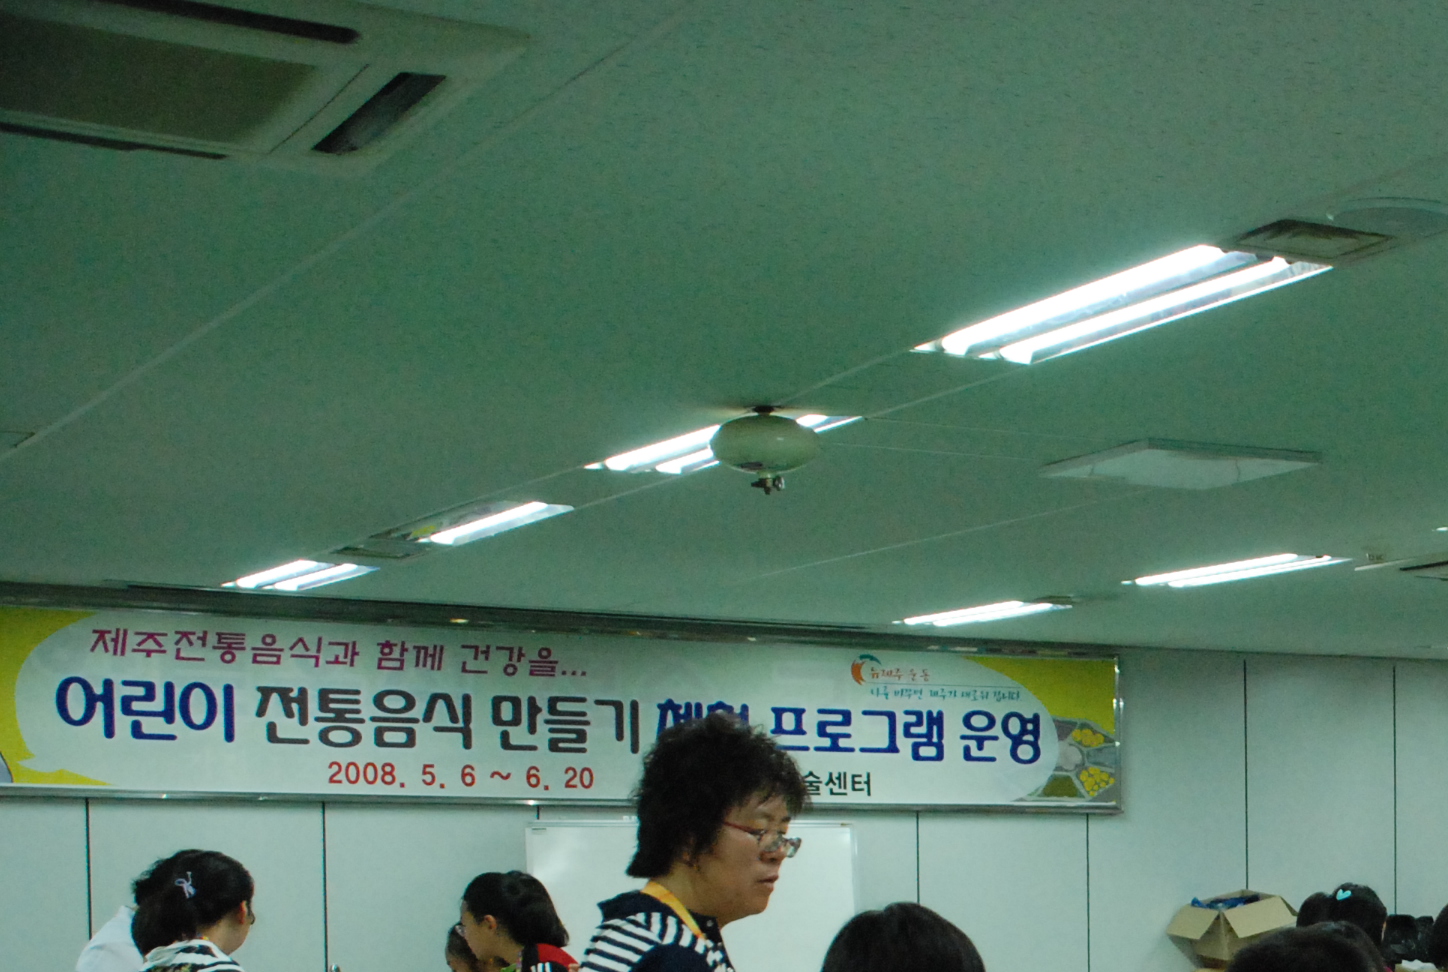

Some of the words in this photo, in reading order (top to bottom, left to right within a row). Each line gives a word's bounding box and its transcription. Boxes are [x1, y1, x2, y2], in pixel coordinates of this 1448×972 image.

[90, 627, 361, 669] 제주전통음식과
[376, 640, 445, 672] 함께
[460, 643, 588, 678] 건강을...
[56, 675, 236, 743] 어린이
[254, 684, 474, 751] 전통음식
[490, 693, 641, 755] 만들기
[770, 705, 945, 763] 프로그램
[959, 708, 1043, 765] 운영
[563, 767, 596, 790] 20
